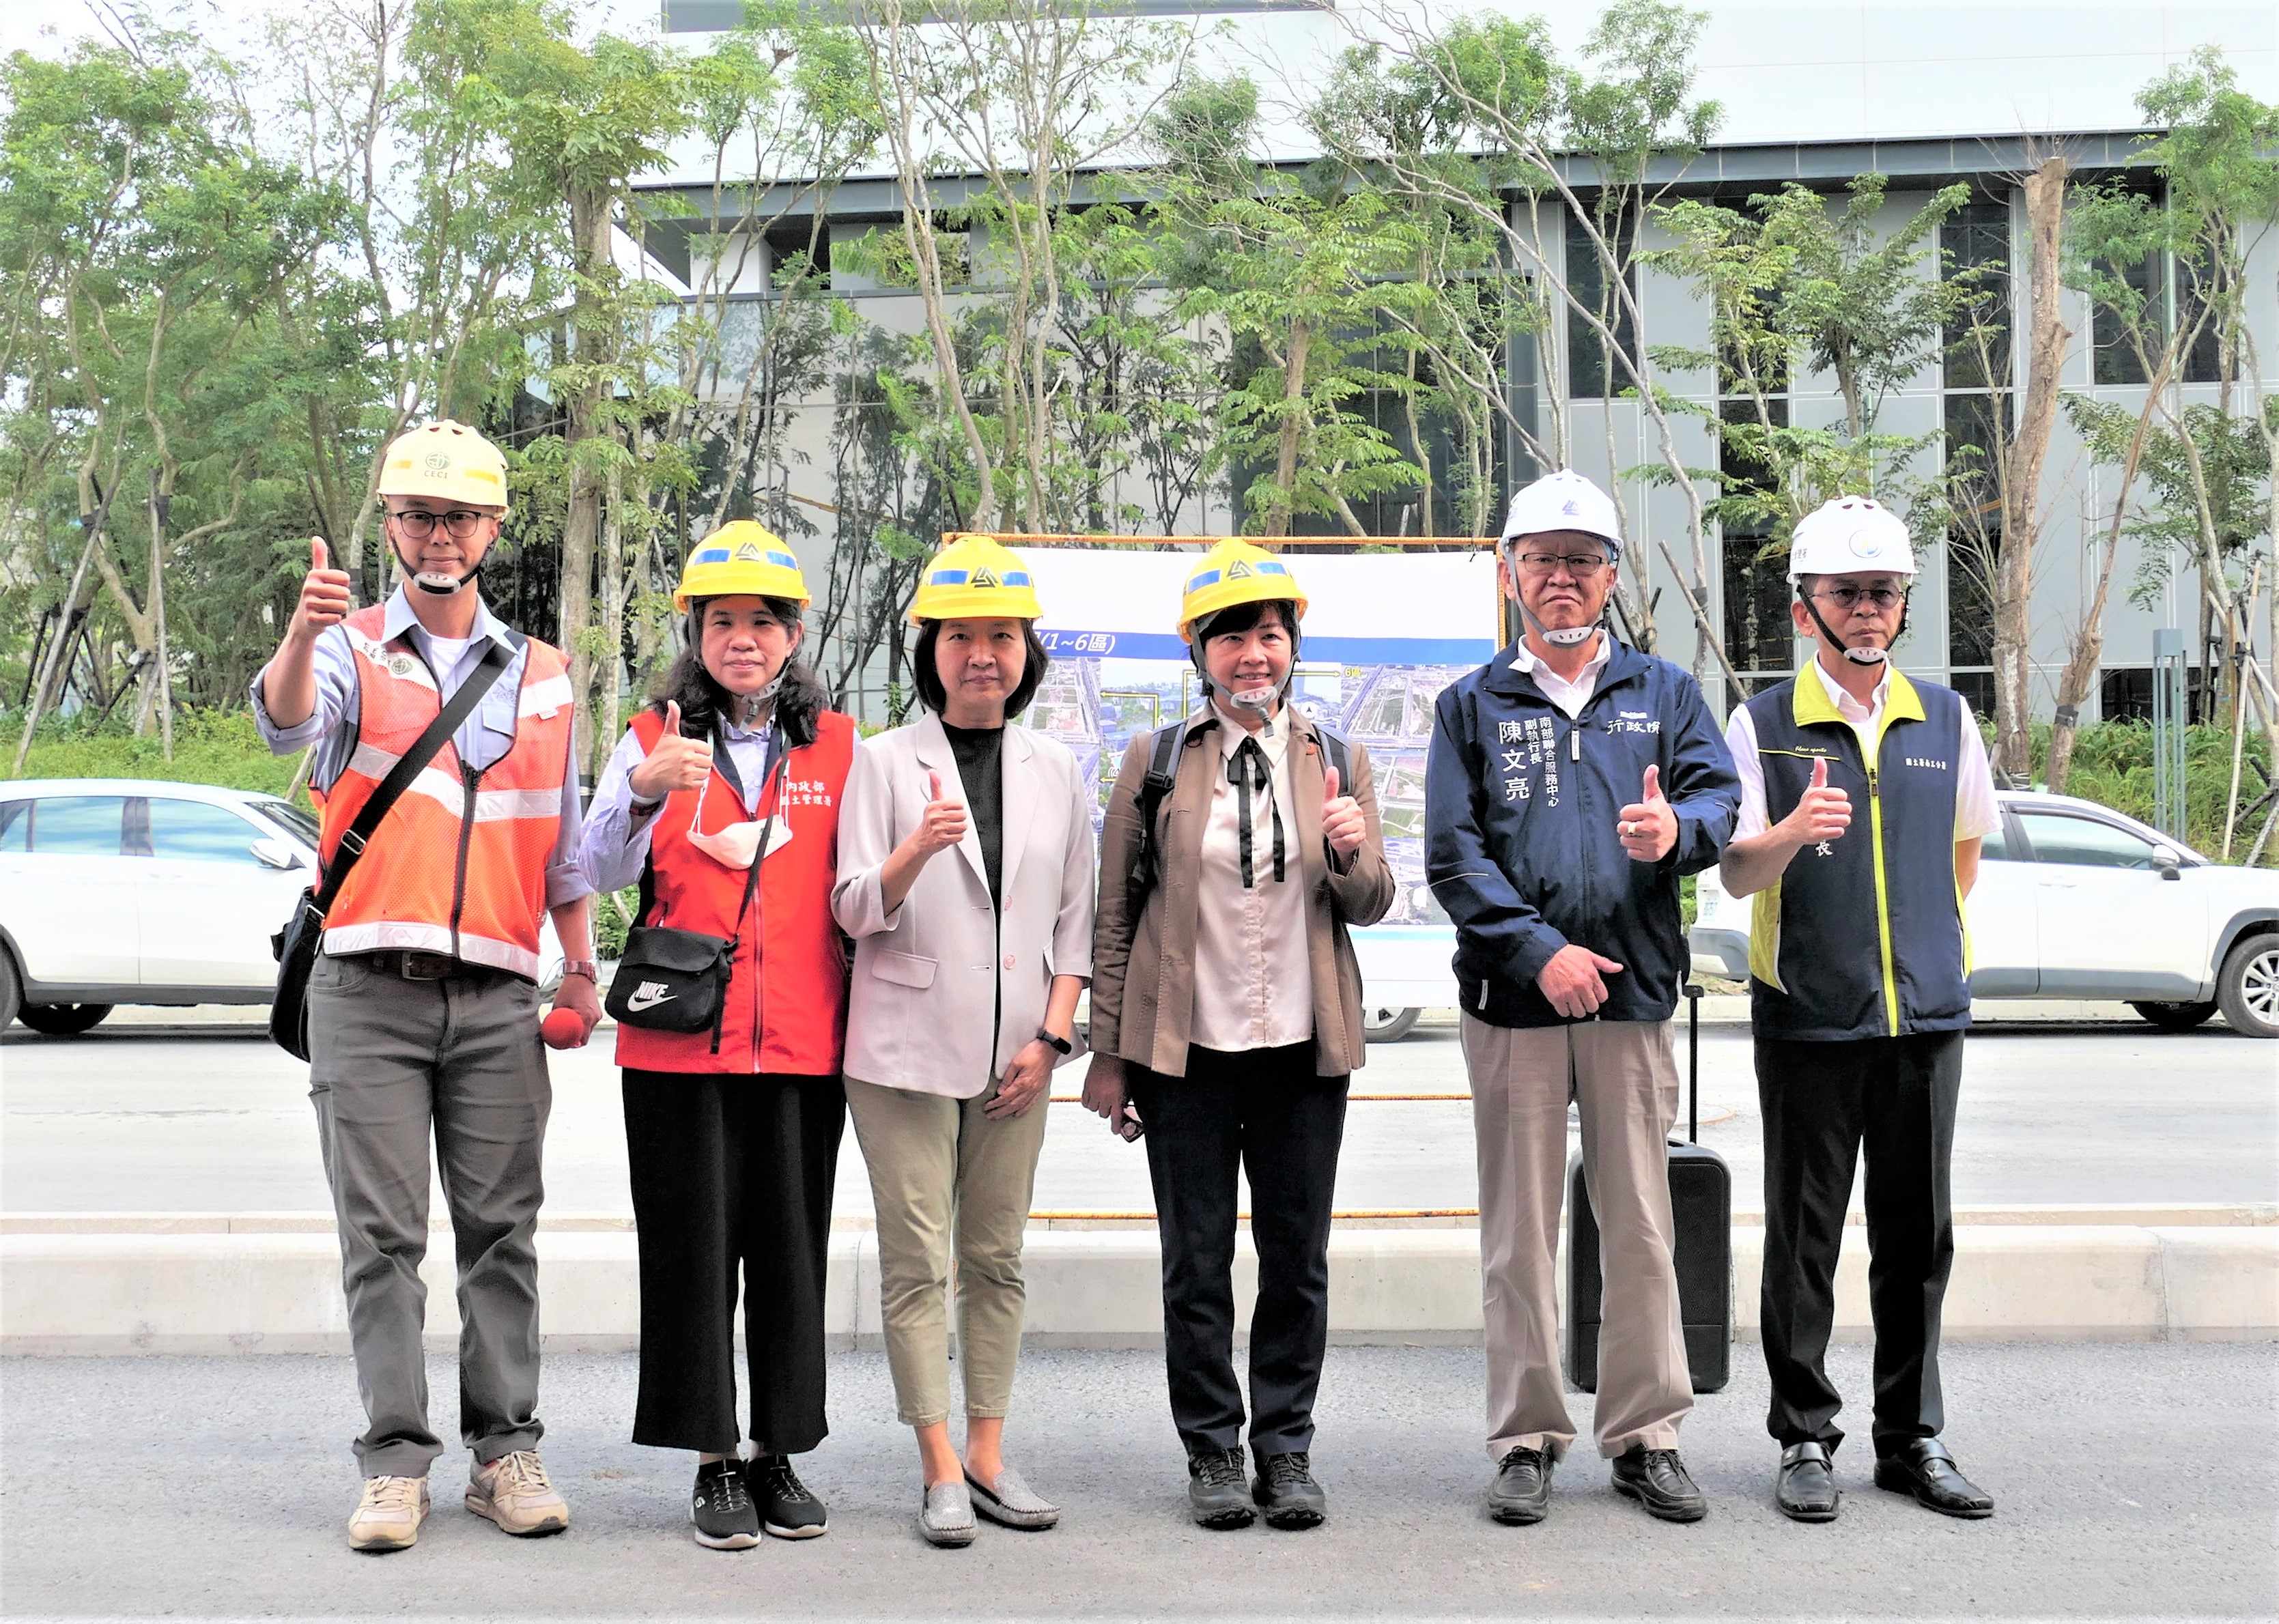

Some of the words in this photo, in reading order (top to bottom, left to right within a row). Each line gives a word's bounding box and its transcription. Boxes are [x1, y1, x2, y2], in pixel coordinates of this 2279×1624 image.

[424, 470, 448, 479] CECI
[1034, 631, 1116, 655] (1~6區)
[1607, 720, 1661, 735] 行政院
[1524, 718, 1542, 765] 副執行長
[1498, 720, 1530, 801] 陳文亮
[1539, 717, 1559, 807] 南部聯合服務中心
[786, 780, 825, 793] 內政部
[635, 980, 669, 1000] NIKE
